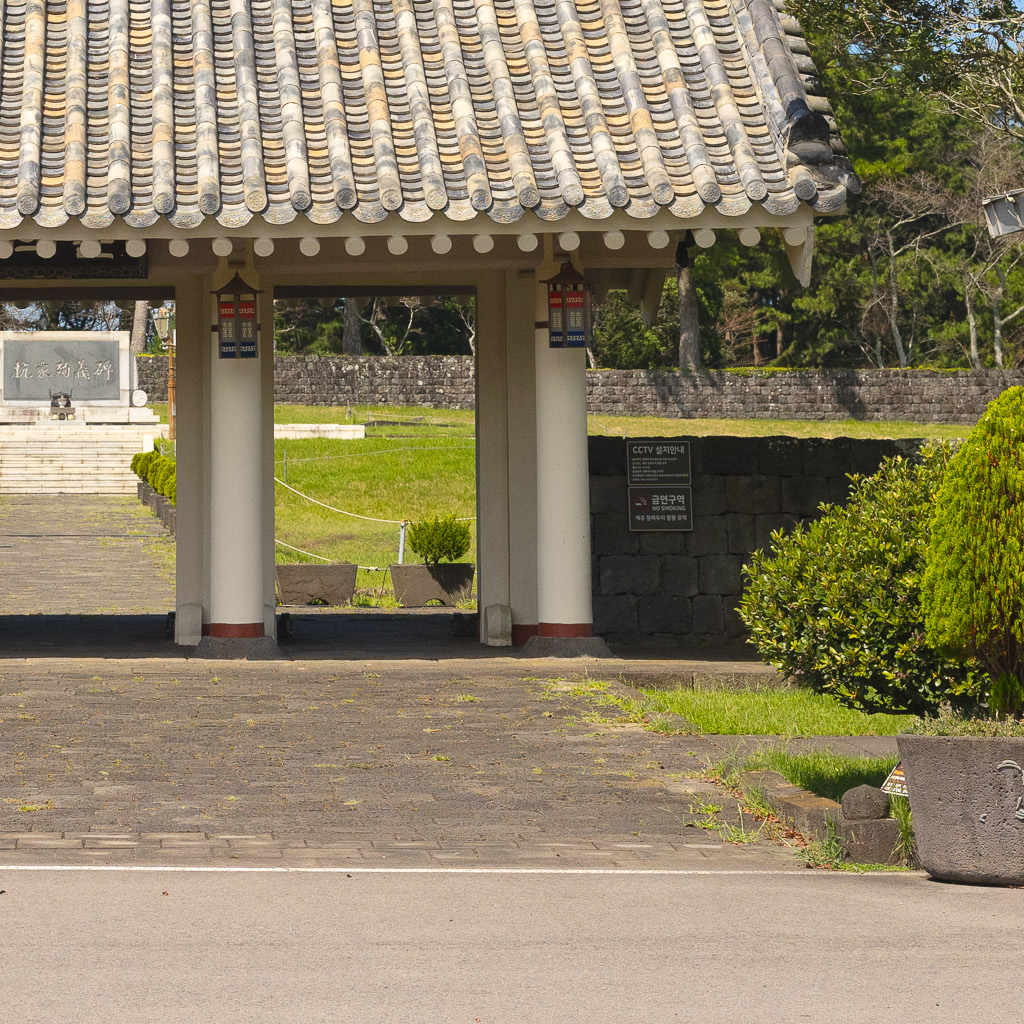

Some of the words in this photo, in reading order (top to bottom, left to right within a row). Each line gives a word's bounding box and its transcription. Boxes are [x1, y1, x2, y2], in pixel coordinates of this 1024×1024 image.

[633, 446, 653, 454] CCTV
[655, 446, 684, 455] 설치안내
[652, 495, 685, 505] 금연구역
